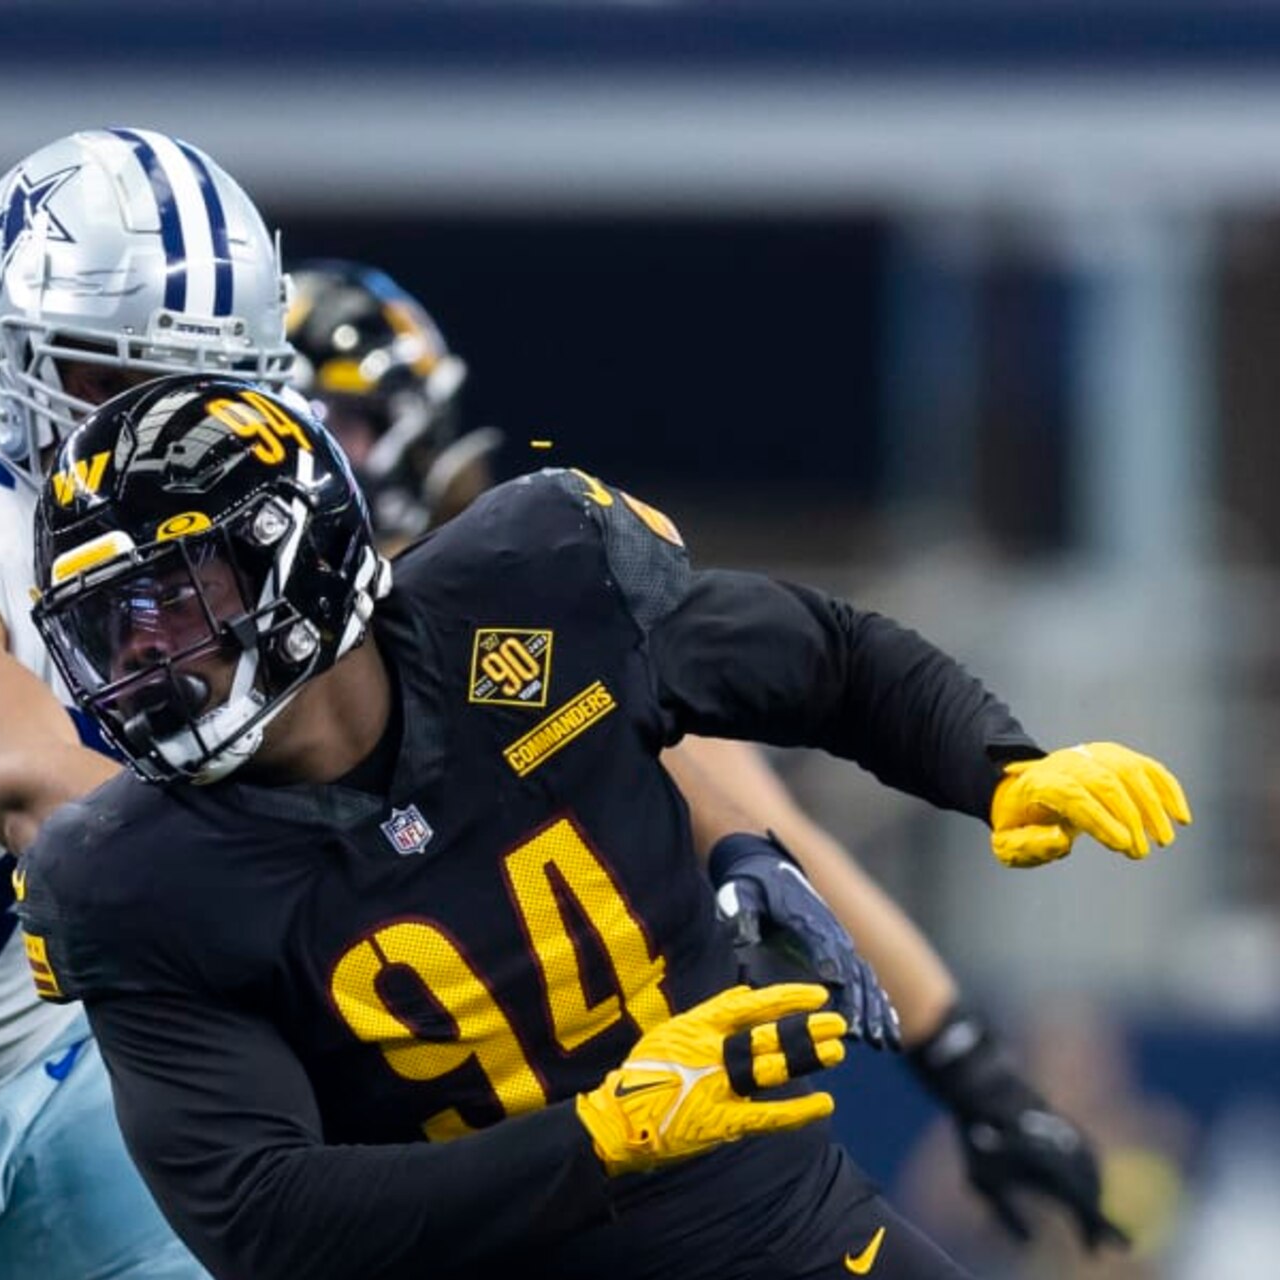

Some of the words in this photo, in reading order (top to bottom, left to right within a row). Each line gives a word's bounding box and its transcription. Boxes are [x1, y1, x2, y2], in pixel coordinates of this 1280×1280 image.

[206, 390, 313, 464] 94
[52, 451, 111, 506] W
[481, 637, 540, 696] 90
[507, 685, 613, 771] COMMANDERS
[329, 815, 675, 1144] 94
